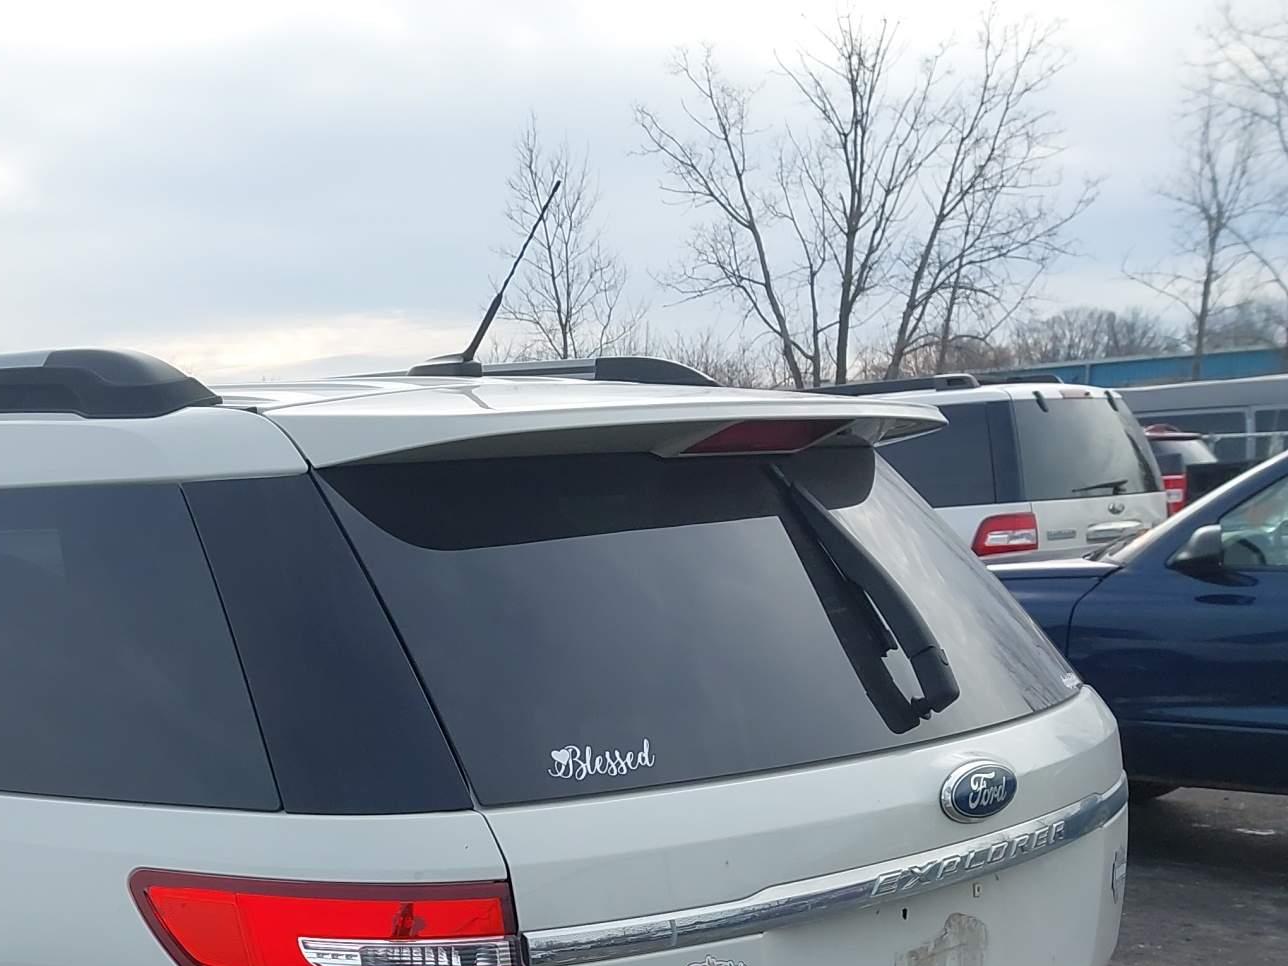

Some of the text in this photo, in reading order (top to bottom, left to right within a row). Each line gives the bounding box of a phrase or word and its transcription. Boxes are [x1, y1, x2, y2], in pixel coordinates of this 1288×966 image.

[548, 738, 655, 780] Blessed
[968, 771, 1007, 810] Ford
[871, 820, 1065, 897] EXPLORER
